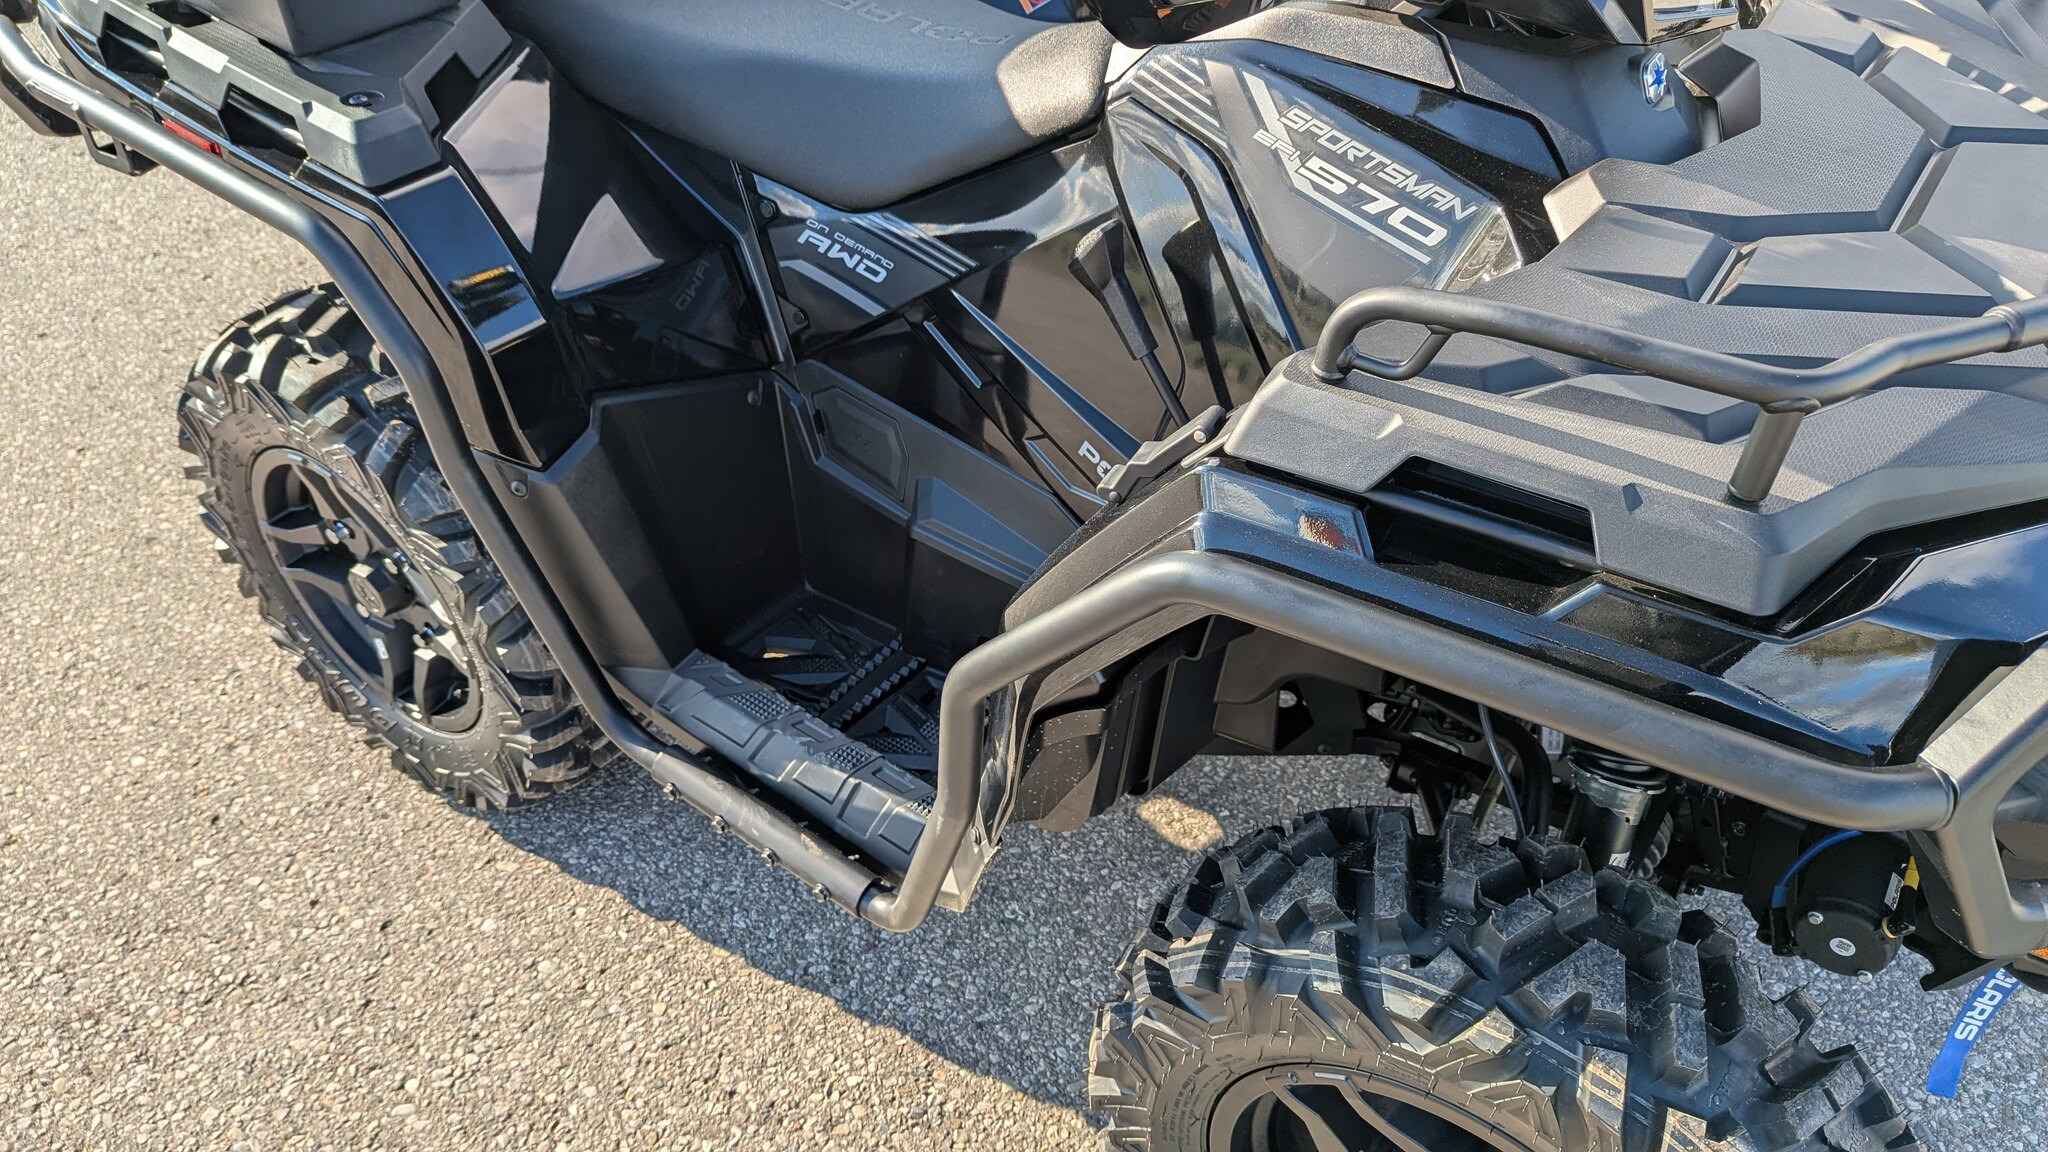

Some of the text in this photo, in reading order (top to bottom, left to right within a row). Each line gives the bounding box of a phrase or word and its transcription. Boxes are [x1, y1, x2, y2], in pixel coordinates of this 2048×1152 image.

[1252, 128, 1301, 162] EFI
[1278, 107, 1478, 220] SPORTSMAN
[1297, 155, 1448, 247] 570
[797, 229, 888, 284] AWD
[834, 232, 895, 270] DEMAND
